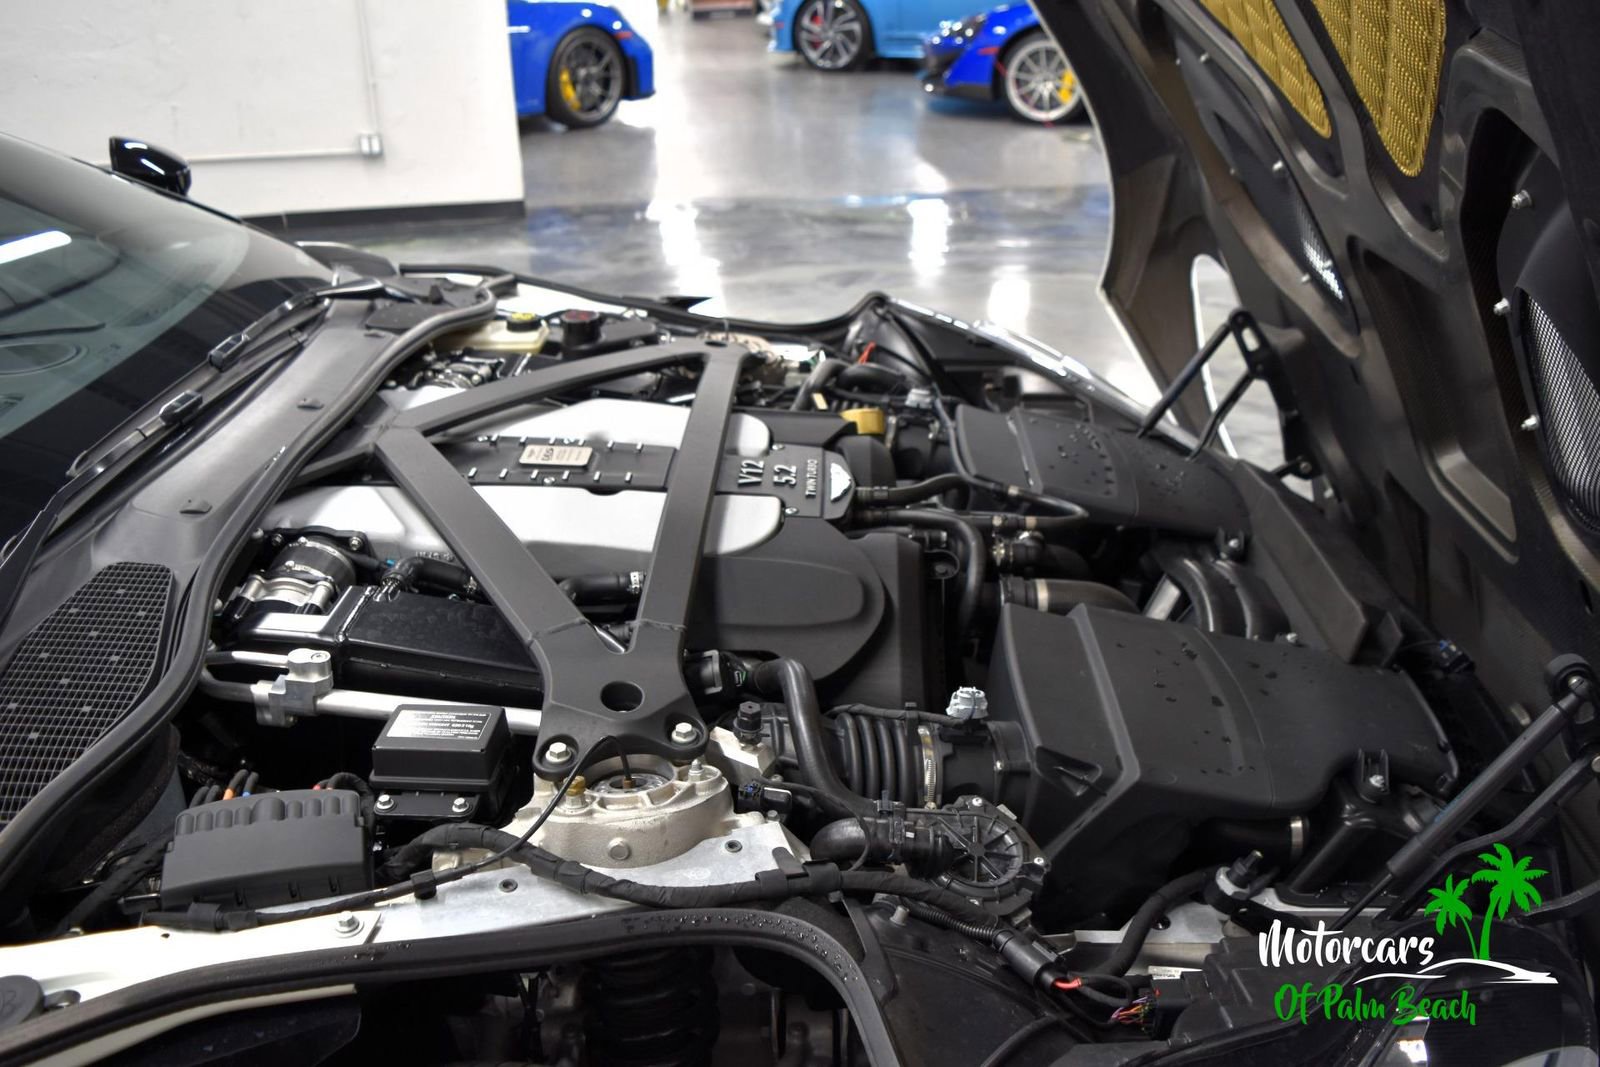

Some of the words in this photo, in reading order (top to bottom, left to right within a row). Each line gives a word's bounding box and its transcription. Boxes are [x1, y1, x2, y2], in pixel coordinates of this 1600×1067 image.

[738, 460, 764, 484] V12
[773, 464, 797, 485] 5.2
[805, 478, 817, 496] TWIN
